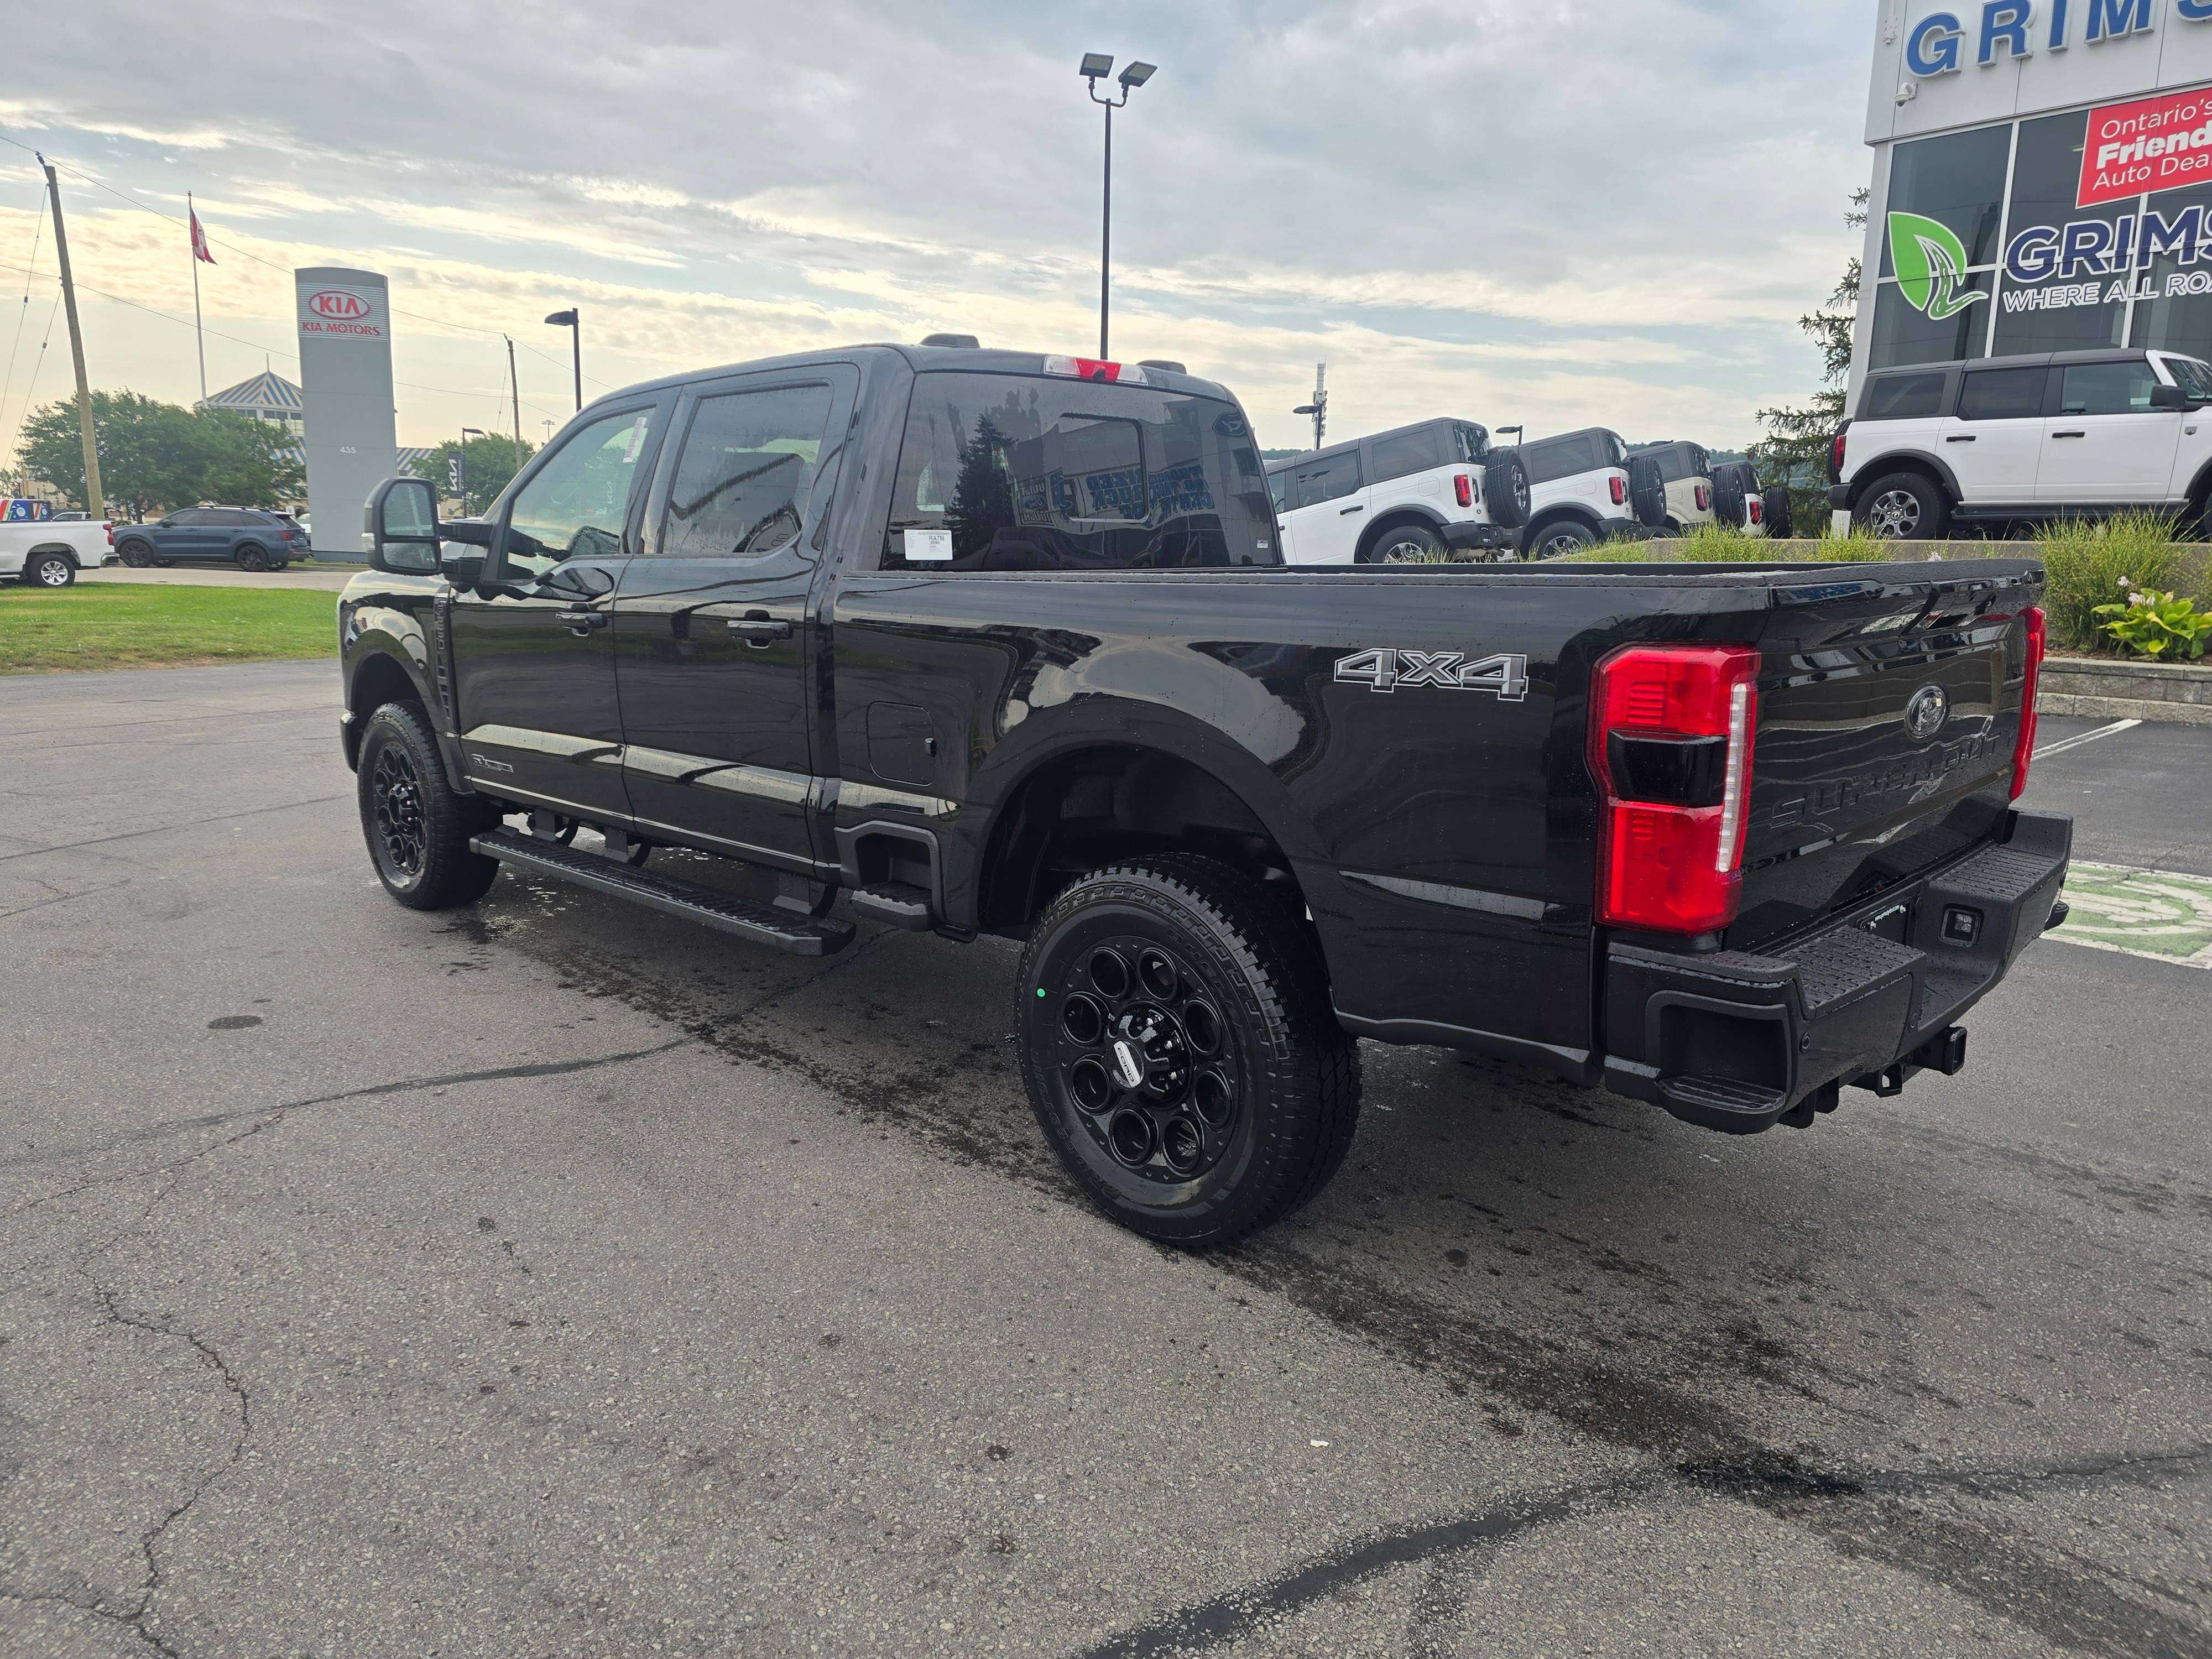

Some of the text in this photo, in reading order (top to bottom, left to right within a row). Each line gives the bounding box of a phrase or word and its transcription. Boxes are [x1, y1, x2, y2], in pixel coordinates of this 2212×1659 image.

[2092, 154, 2212, 191] Auto Dea
[318, 295, 361, 315] KIA
[2003, 282, 2101, 313] WHERE
[2103, 277, 2159, 304] ALL
[302, 322, 380, 336] KIA MOTORS
[1117, 1047, 1134, 1082] FORD
